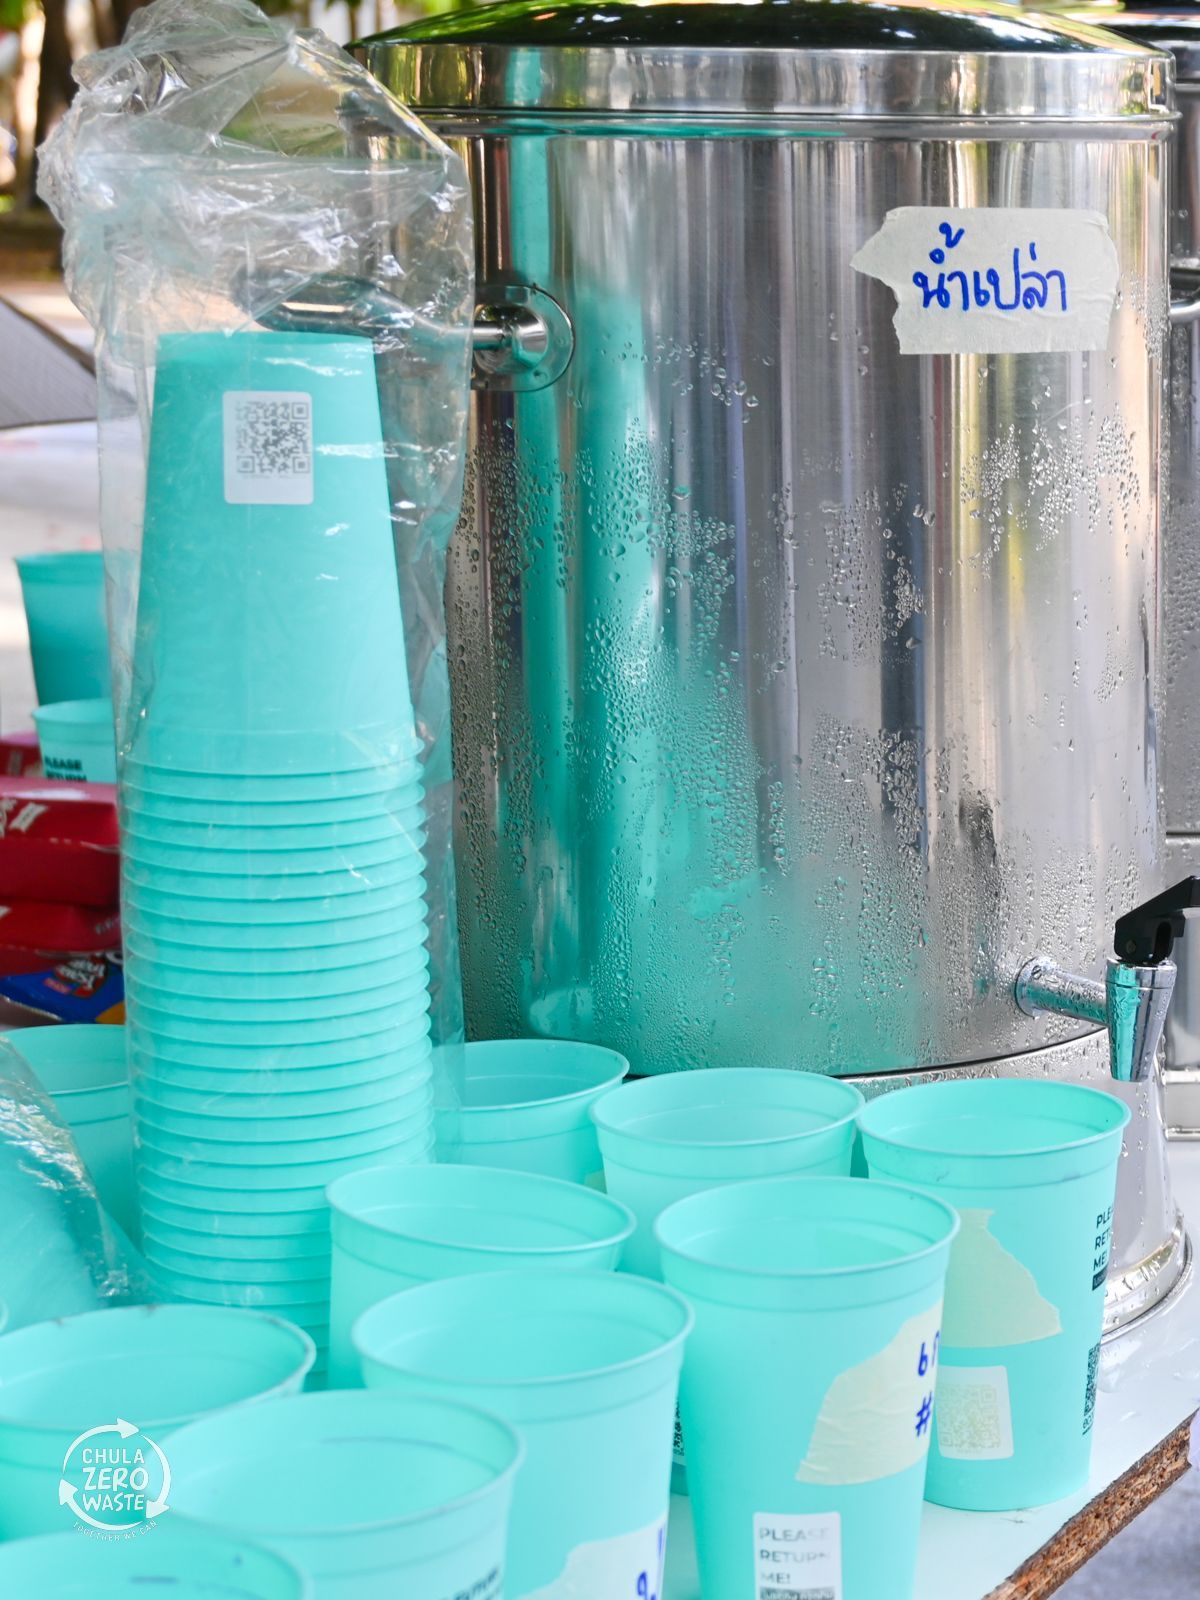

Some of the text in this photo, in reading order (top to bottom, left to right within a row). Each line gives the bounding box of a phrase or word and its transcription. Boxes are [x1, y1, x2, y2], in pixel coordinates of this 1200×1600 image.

[912, 222, 1067, 311] น้ำเปล่า
[761, 1572, 791, 1584] ME!
